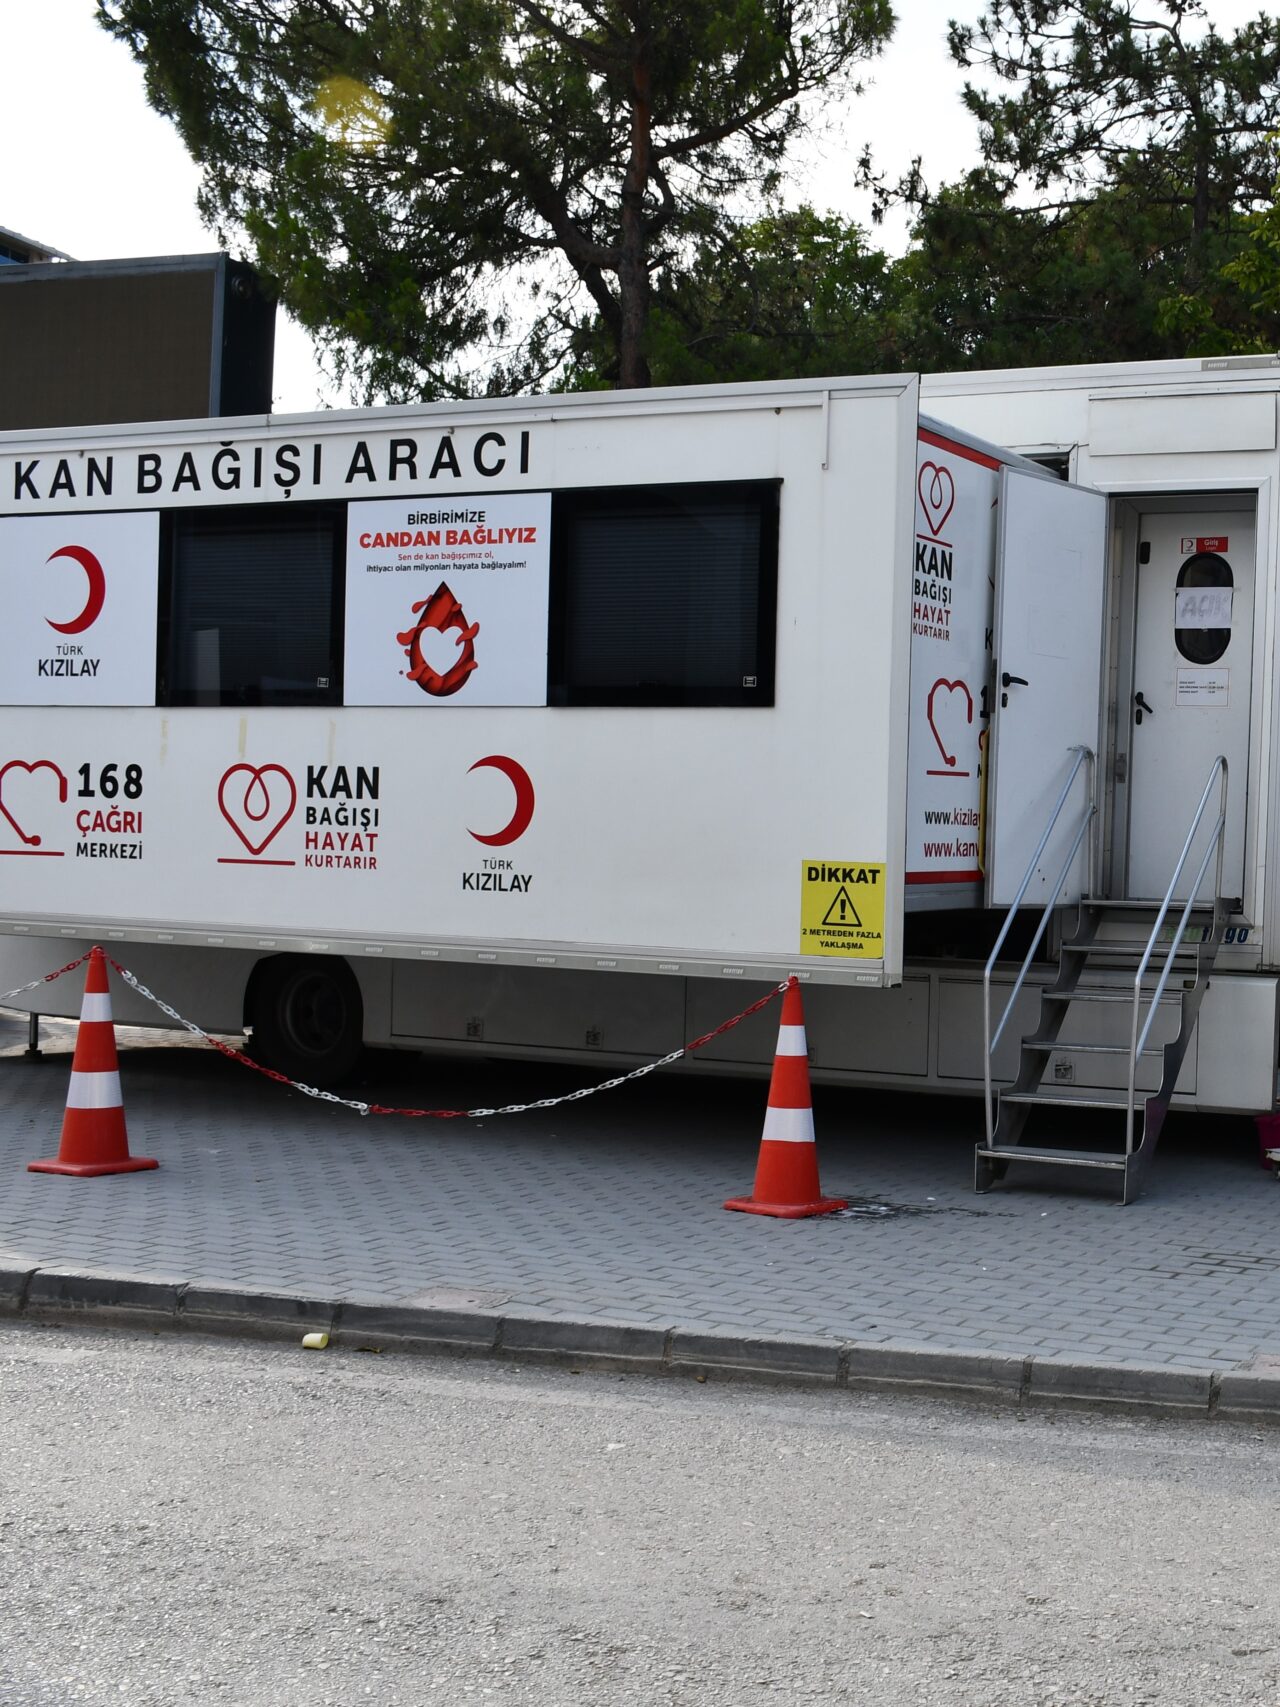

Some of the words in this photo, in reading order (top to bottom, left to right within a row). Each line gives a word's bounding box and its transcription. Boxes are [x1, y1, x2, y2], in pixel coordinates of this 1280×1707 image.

[14, 456, 114, 500] KAN
[137, 441, 322, 499] BAĞIŞI
[345, 431, 530, 484] ARACI
[407, 508, 486, 525] BİRBİRİMİZE
[359, 531, 441, 549] CANDAN
[446, 525, 537, 546] BAĞLIYIZ
[398, 553, 412, 561] Sen
[414, 553, 424, 561] de
[425, 552, 439, 561] kan
[441, 552, 483, 562] bağışçımız
[484, 551, 494, 560] ol,
[915, 542, 953, 581] KAN
[395, 564, 412, 572] olan
[413, 563, 451, 573] milyonları
[452, 562, 479, 571] hayata
[481, 561, 527, 571] bağlayalım!
[914, 578, 952, 607] BAĞIŞI
[913, 602, 951, 627] HAYAT
[913, 622, 950, 641] KURTARIR
[56, 643, 84, 656] TÜRK
[38, 659, 101, 677] KIZILAY
[78, 763, 143, 800] 168
[307, 765, 380, 800] KAN
[76, 805, 143, 838] ÇAĞRI
[306, 802, 379, 832] BAĞIŞI
[76, 840, 143, 860] MERKEZİ
[305, 831, 379, 852] HAYAT
[305, 854, 377, 870] KURTARIR
[483, 857, 513, 870] TÜRK
[463, 872, 533, 893] KIZILAY
[807, 864, 881, 884] DİKKAT
[809, 929, 854, 937] METREDEN
[856, 931, 882, 939] FAZLA
[819, 940, 865, 950] YAKLAŞMA
